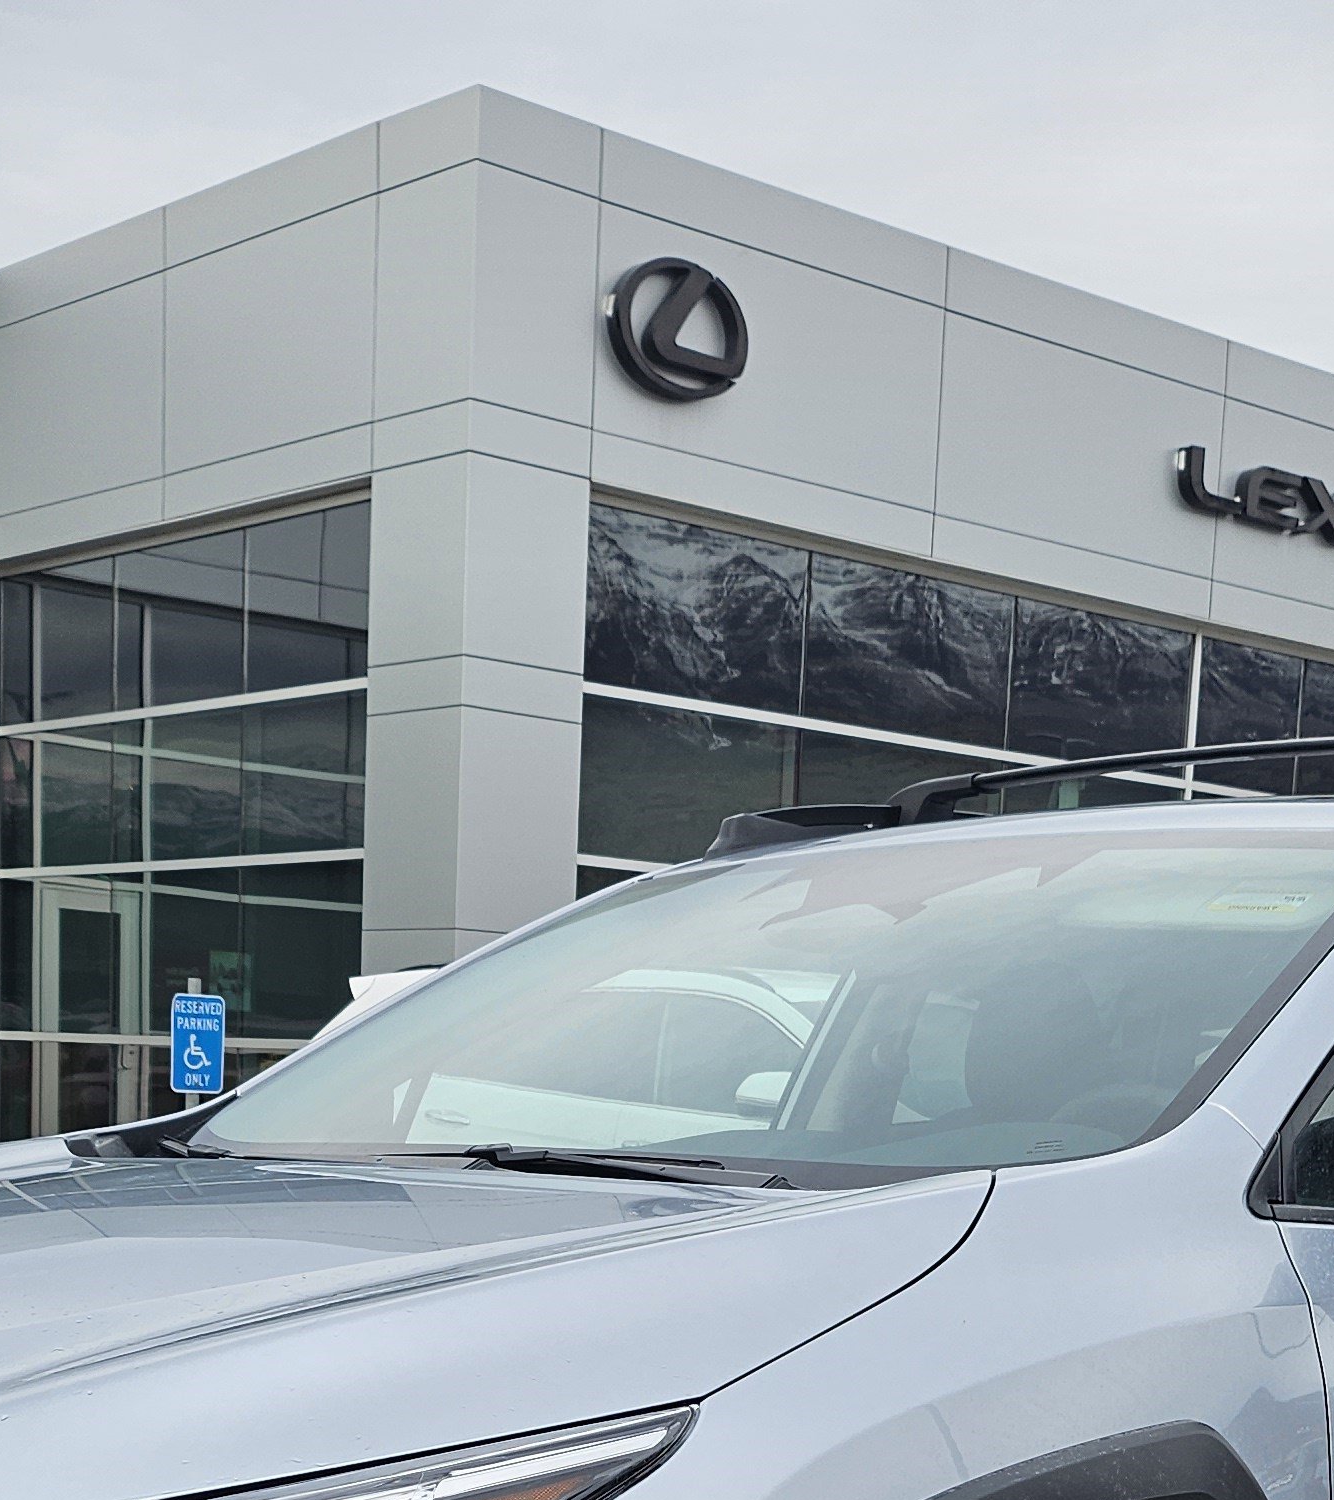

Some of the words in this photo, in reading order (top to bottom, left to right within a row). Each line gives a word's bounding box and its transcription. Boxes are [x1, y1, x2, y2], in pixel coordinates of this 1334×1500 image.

[174, 1000, 222, 1016] RESERVED
[176, 1016, 220, 1032] PARKING
[184, 1072, 211, 1087] ONLY
